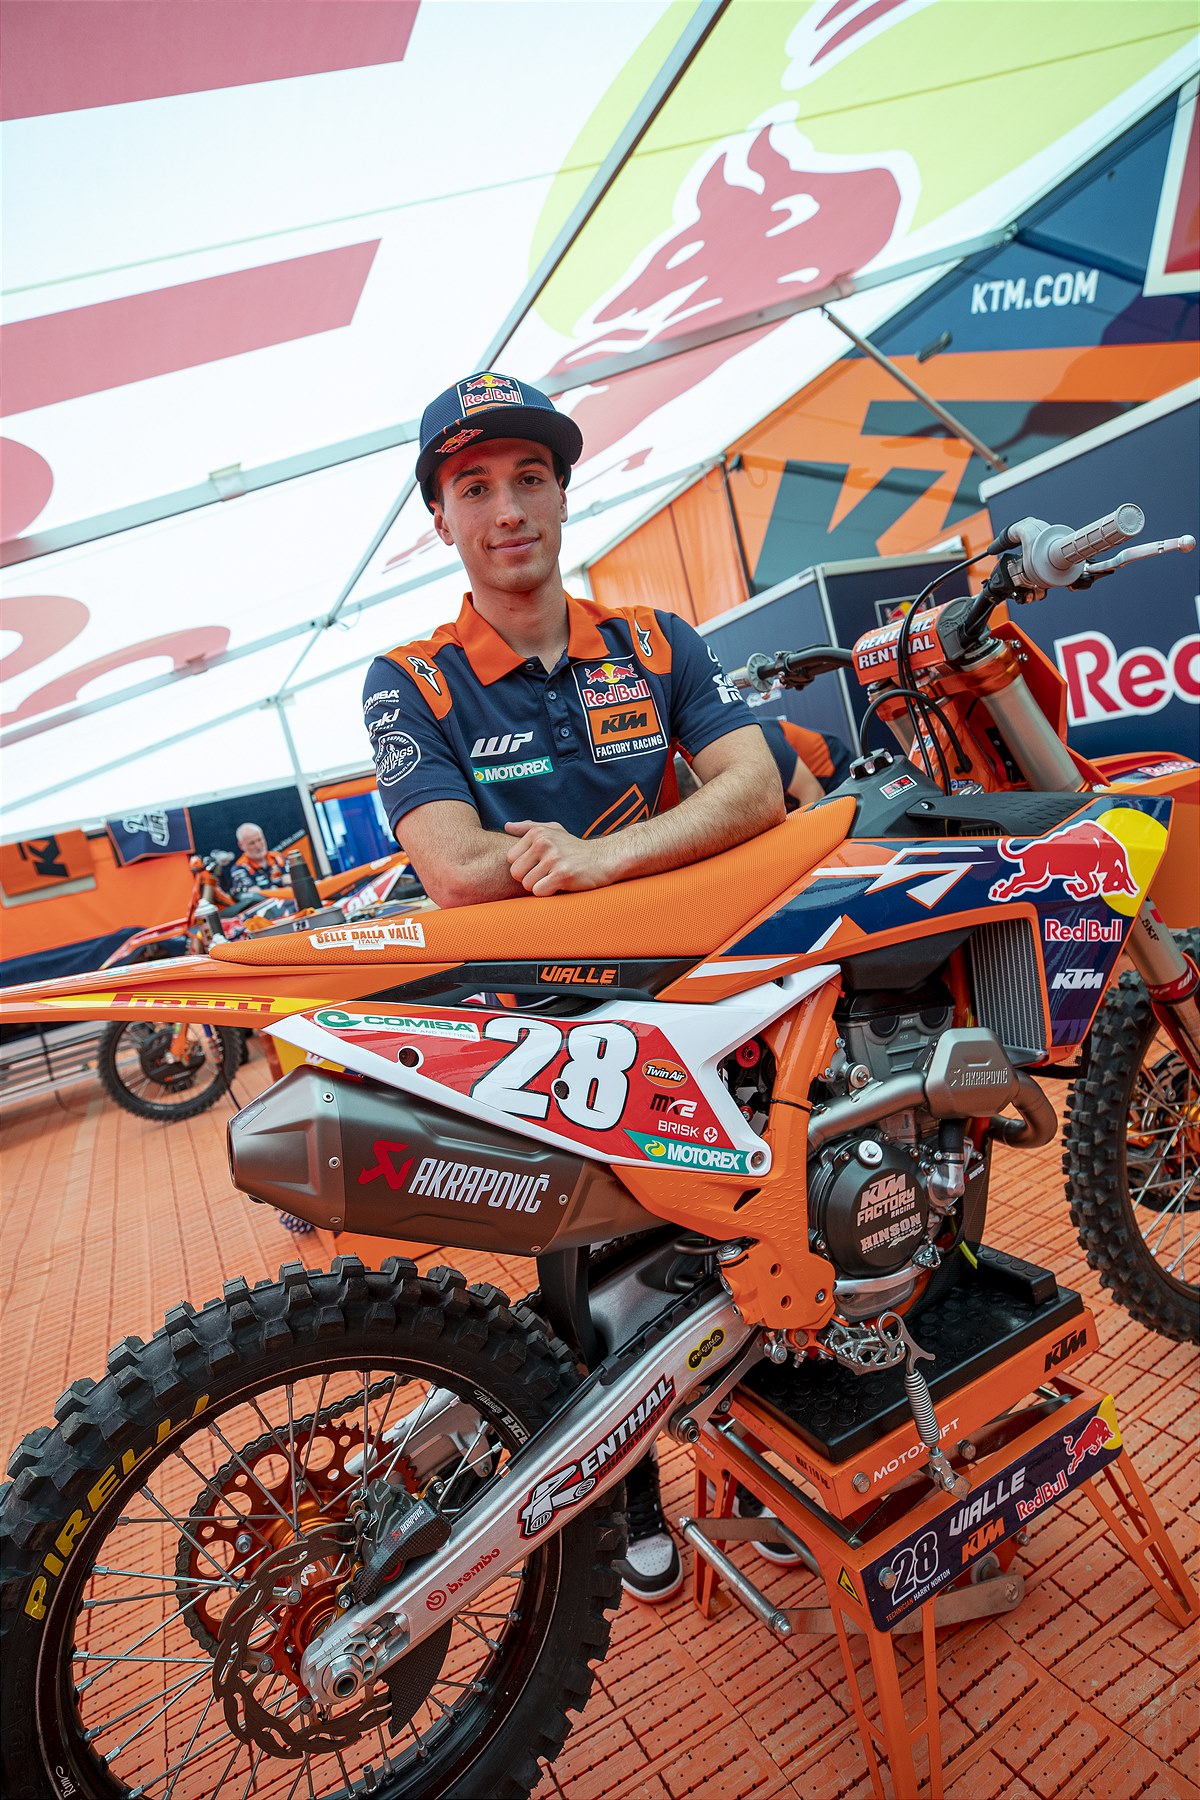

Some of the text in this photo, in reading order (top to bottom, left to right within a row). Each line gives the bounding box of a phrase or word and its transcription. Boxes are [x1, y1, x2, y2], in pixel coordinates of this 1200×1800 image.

[970, 269, 1100, 314] KTM.COM
[463, 388, 521, 407] Red Bull
[856, 616, 935, 653] RENTAL
[582, 678, 651, 708] Red Bull
[601, 710, 648, 735] KTM
[470, 730, 534, 758] WP
[596, 734, 663, 758] FACTORY RACING
[485, 757, 551, 782] MOTOREX
[351, 929, 385, 940] DALLA
[388, 925, 420, 941] VALLE
[1045, 917, 1123, 942] Red Bull
[1141, 918, 1160, 942] SKF
[1051, 968, 1104, 990] KTM
[363, 1016, 474, 1033] COMISA
[470, 1016, 638, 1131] 28
[646, 1065, 685, 1082] Twin Air
[650, 1093, 698, 1118] MX2
[658, 1119, 700, 1138] BRISK
[668, 1143, 744, 1170] MOTOREX
[408, 1157, 552, 1213] AKRAPOVIČ
[860, 1173, 906, 1210] KTM
[857, 1187, 916, 1227] FACTORY
[890, 1201, 915, 1218] RACING
[860, 1212, 921, 1252] HINSON
[690, 1333, 722, 1363] REGINA
[1044, 1328, 1087, 1373] KTM
[501, 1414, 529, 1445] EXCE
[521, 1377, 674, 1536] RENTHAL
[873, 1417, 960, 1484] MOTOXIFT
[23, 1392, 211, 1621] PIRELLI
[1016, 1470, 1069, 1521] Red Bull
[961, 1517, 1006, 1565] KTM
[446, 1548, 501, 1595] brembo
[890, 1530, 938, 1606] 28
[885, 1567, 951, 1622] TECHNICIAN HARRY NORTON
